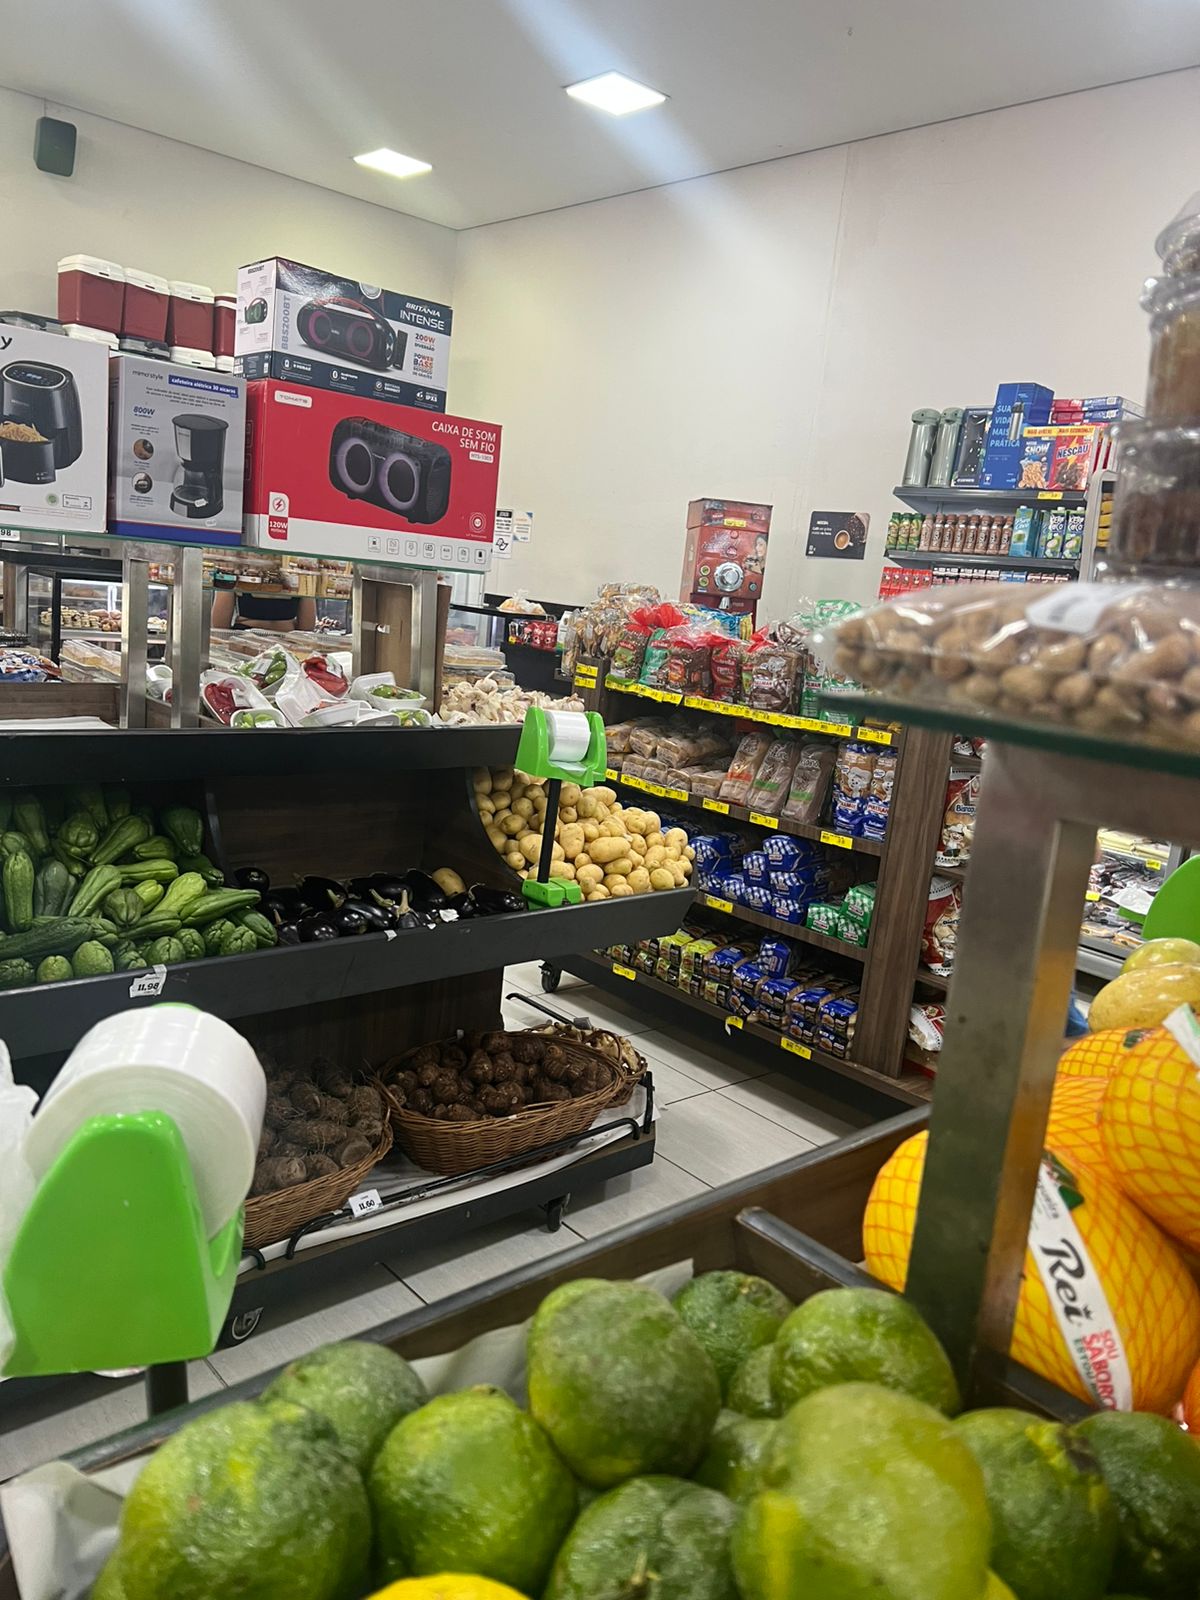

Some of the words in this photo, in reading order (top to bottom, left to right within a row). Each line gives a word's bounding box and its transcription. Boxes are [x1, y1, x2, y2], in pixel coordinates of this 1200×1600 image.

[400, 309, 445, 331] INTENSE
[415, 333, 436, 344] 200W
[414, 352, 434, 362] POWER
[413, 358, 434, 369] BASS
[133, 405, 156, 416] 800W
[996, 405, 1012, 413] SUA
[995, 416, 1012, 425] VIDA
[431, 421, 460, 436] CAIXA
[461, 427, 475, 438] DE
[475, 429, 496, 442] SOM
[992, 428, 1010, 436] MAIS
[459, 437, 479, 449] SEM
[480, 441, 495, 453] FIO
[989, 438, 1021, 447] PRÁTICA
[1025, 442, 1051, 455] SNOW
[1056, 444, 1089, 459] NESCAU
[269, 520, 288, 529] 120W
[137, 982, 160, 992] 11.98
[358, 1199, 376, 1211] 11.60
[1040, 1238, 1093, 1325] Rei
[1099, 1329, 1120, 1360] SOU
